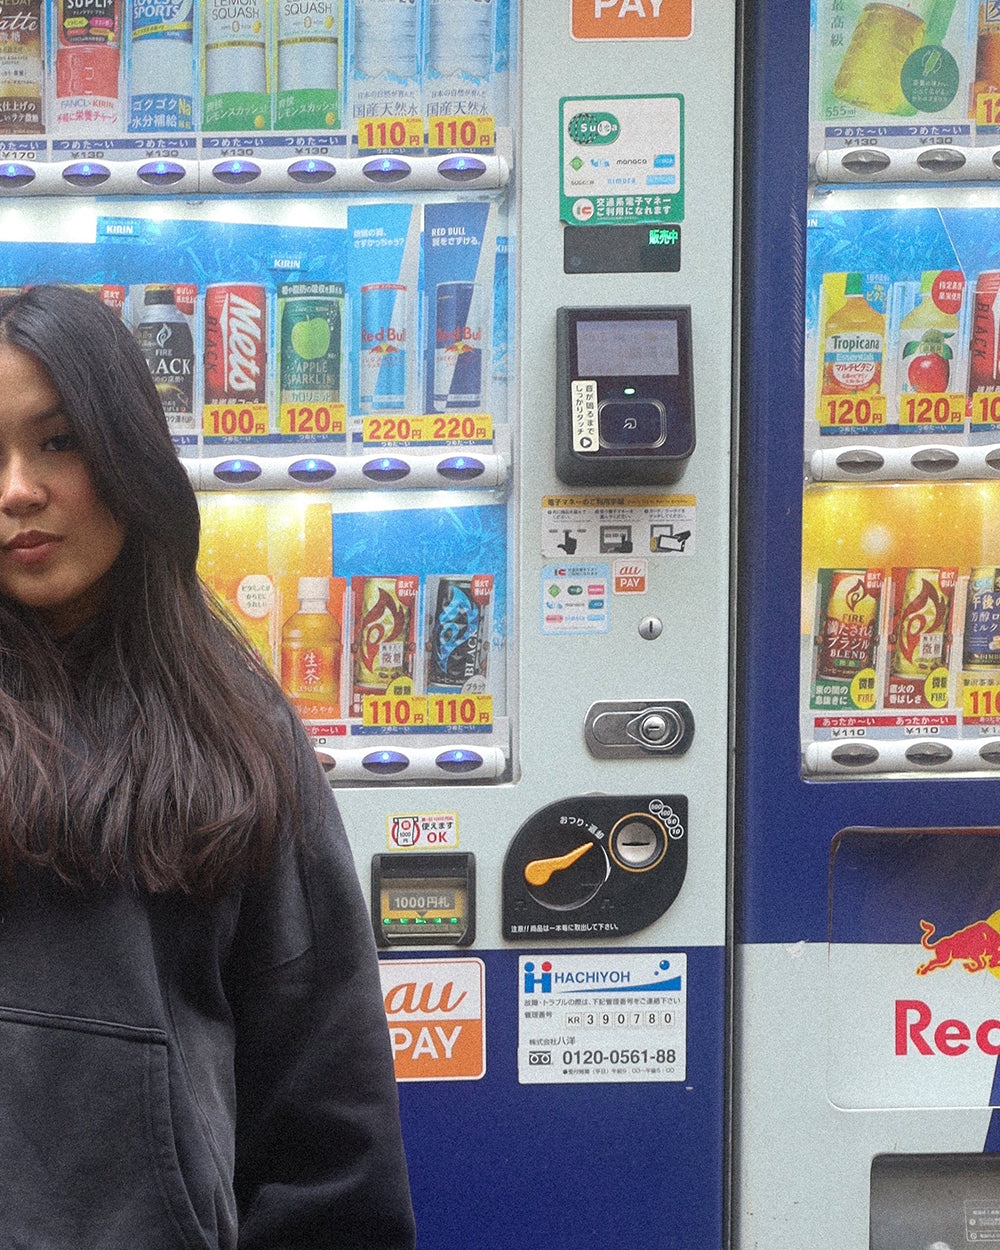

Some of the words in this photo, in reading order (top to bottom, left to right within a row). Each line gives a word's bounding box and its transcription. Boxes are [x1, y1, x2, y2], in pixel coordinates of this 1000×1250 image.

[133, 5, 180, 19] SPORTS
[211, 7, 260, 21] SQUASH
[284, 2, 333, 16] SQUASH
[133, 98, 178, 111] ゴクゴク
[352, 102, 419, 118] 国産天然水
[426, 101, 489, 116] 国産天然水
[131, 113, 178, 128] 水分補給
[364, 121, 420, 147] 110円
[434, 120, 490, 146] 110円
[834, 127, 888, 136] つめた〜い
[908, 126, 962, 135] つめた〜い
[61, 140, 114, 149] つめた〜い
[135, 139, 189, 148] つめた〜い
[210, 138, 264, 146] つめた〜い
[285, 136, 338, 145] つめた〜い
[844, 138, 878, 146] ¥130
[919, 137, 953, 145] ¥130
[1, 151, 36, 160] ¥170
[70, 151, 105, 159] ¥130
[220, 148, 254, 156] ¥130
[295, 147, 329, 155] ¥130
[105, 225, 134, 235] KIRIN
[431, 228, 447, 236] RED
[448, 227, 466, 236] BULL
[648, 228, 679, 245] 販売中
[273, 258, 301, 269] KIRIN
[973, 301, 990, 360] BLACK
[228, 292, 262, 394] Mets
[831, 335, 880, 351] Tropicana
[147, 358, 191, 375] LACK
[827, 398, 883, 424] 120円
[906, 397, 961, 423] 120円
[210, 408, 266, 434] 100円
[287, 406, 343, 433] 120円
[369, 418, 422, 441] 220円
[433, 416, 486, 440] 220円
[618, 565, 642, 576] au
[619, 578, 641, 588] PAY
[841, 613, 865, 623] FIRE
[827, 637, 870, 650] ブラジル
[464, 627, 479, 678] BLACK
[829, 650, 866, 659] BLEND
[303, 652, 321, 685] 生茶
[369, 699, 424, 724] 110円
[435, 697, 489, 724] 110円
[822, 717, 875, 726] あったか〜い
[896, 715, 949, 725] あったか〜い
[832, 728, 866, 737] ¥110
[905, 726, 939, 735] ¥110
[422, 821, 454, 830] 使えます
[427, 831, 448, 844] OK
[394, 895, 451, 909] 1000円札
[554, 970, 631, 984] HACHIYOH
[384, 980, 468, 1015] au
[524, 1011, 553, 1019] 管理番号
[567, 1016, 580, 1024] KR
[392, 1025, 463, 1061] PAY
[529, 1035, 576, 1046] 株式会社八洋
[562, 1049, 677, 1066] 0120-0561-88
